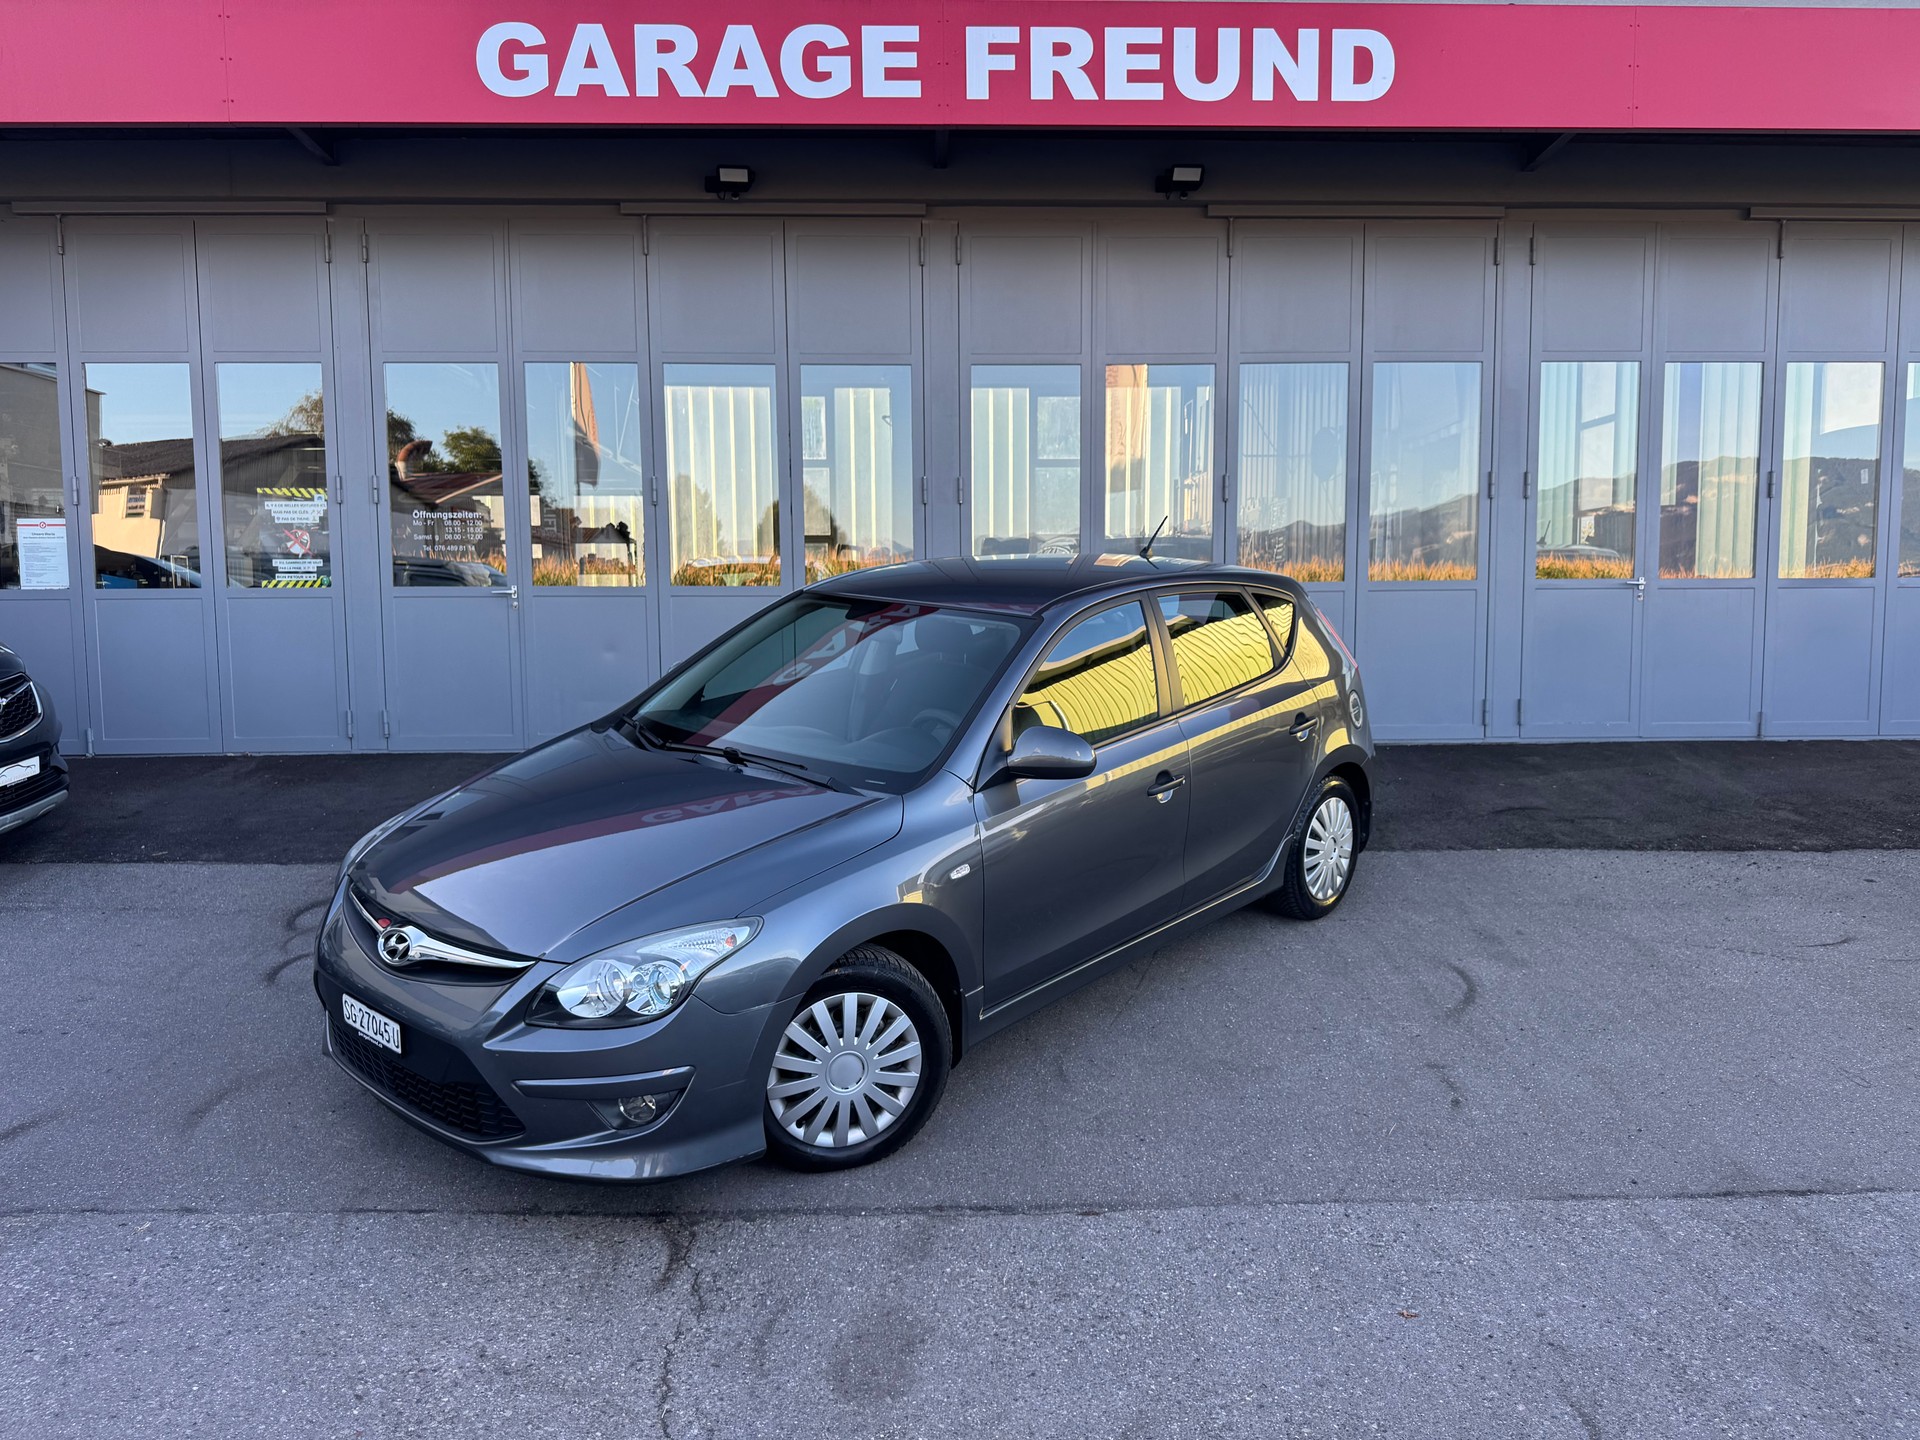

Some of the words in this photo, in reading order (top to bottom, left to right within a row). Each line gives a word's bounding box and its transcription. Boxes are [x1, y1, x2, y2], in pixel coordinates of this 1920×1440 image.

[475, 21, 922, 99] GARAGE
[965, 26, 1396, 102] FREUND
[413, 510, 482, 520] Öffnungszeiten:
